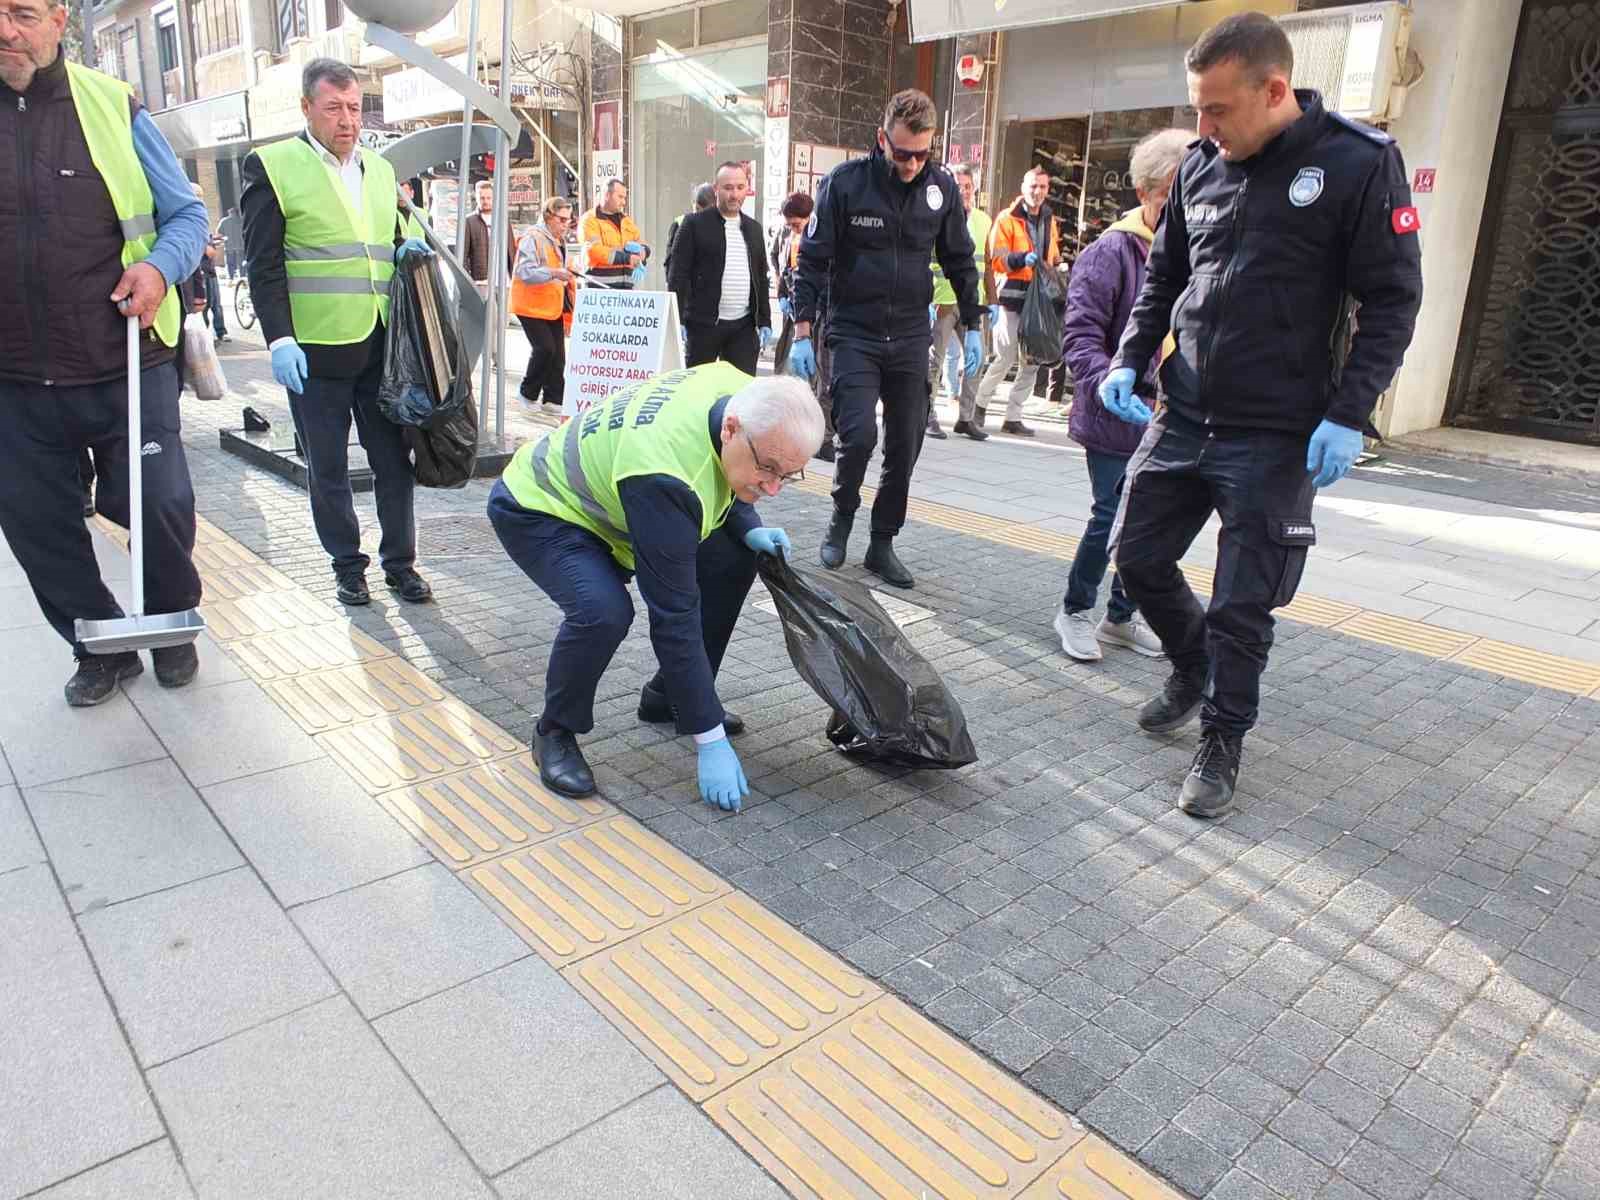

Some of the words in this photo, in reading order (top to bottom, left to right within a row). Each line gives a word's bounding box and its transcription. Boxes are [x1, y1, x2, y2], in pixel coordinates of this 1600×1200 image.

[597, 160, 617, 177] ÖVGÜ
[851, 215, 884, 228] ZABITA
[582, 293, 597, 306] ALİ
[599, 293, 655, 310] ÇETİNKAYA
[578, 313, 590, 324] VE
[592, 312, 621, 326] BAĞLI
[623, 316, 659, 329] CADDE
[582, 331, 649, 346] SOKAKLARDA
[590, 349, 638, 362] MOTORLU
[570, 365, 624, 379] MOTORSUZ
[580, 381, 609, 398] GİRİŞİ
